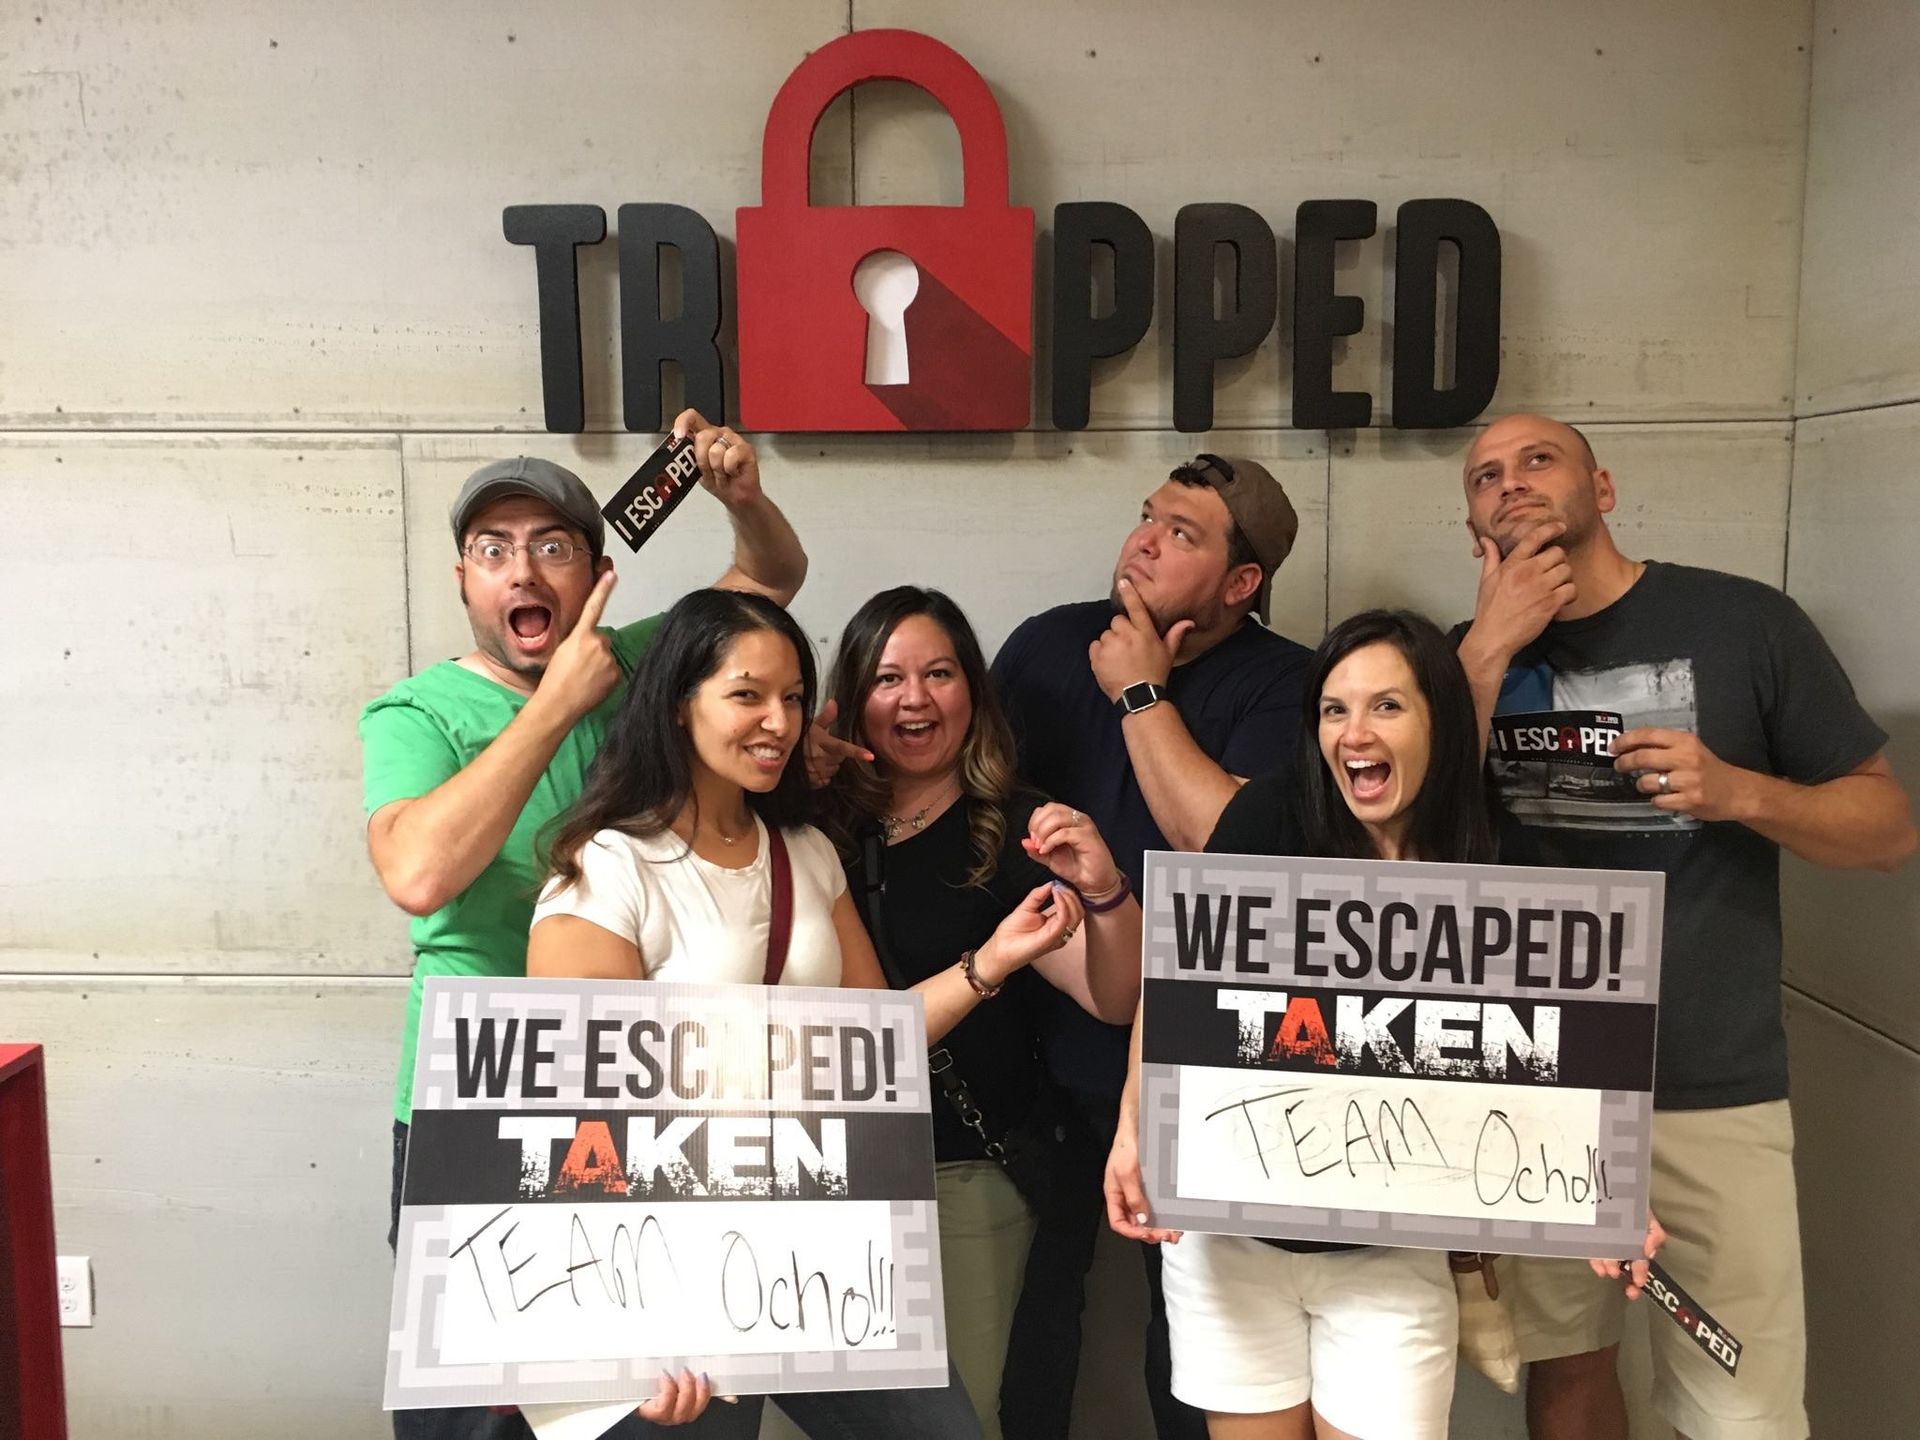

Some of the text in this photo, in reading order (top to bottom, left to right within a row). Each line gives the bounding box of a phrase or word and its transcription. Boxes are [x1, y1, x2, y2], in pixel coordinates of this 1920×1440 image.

[615, 520, 633, 541] I
[1498, 729, 1507, 751] I
[1173, 893, 1625, 992] WE ESCAPED!
[455, 1017, 897, 1102] WE ESCPED!
[1217, 989, 1561, 1082] TAKEN
[499, 1116, 848, 1198] TAKEN
[1205, 1087, 1449, 1187] TEAM
[449, 1206, 682, 1324] TEAM
